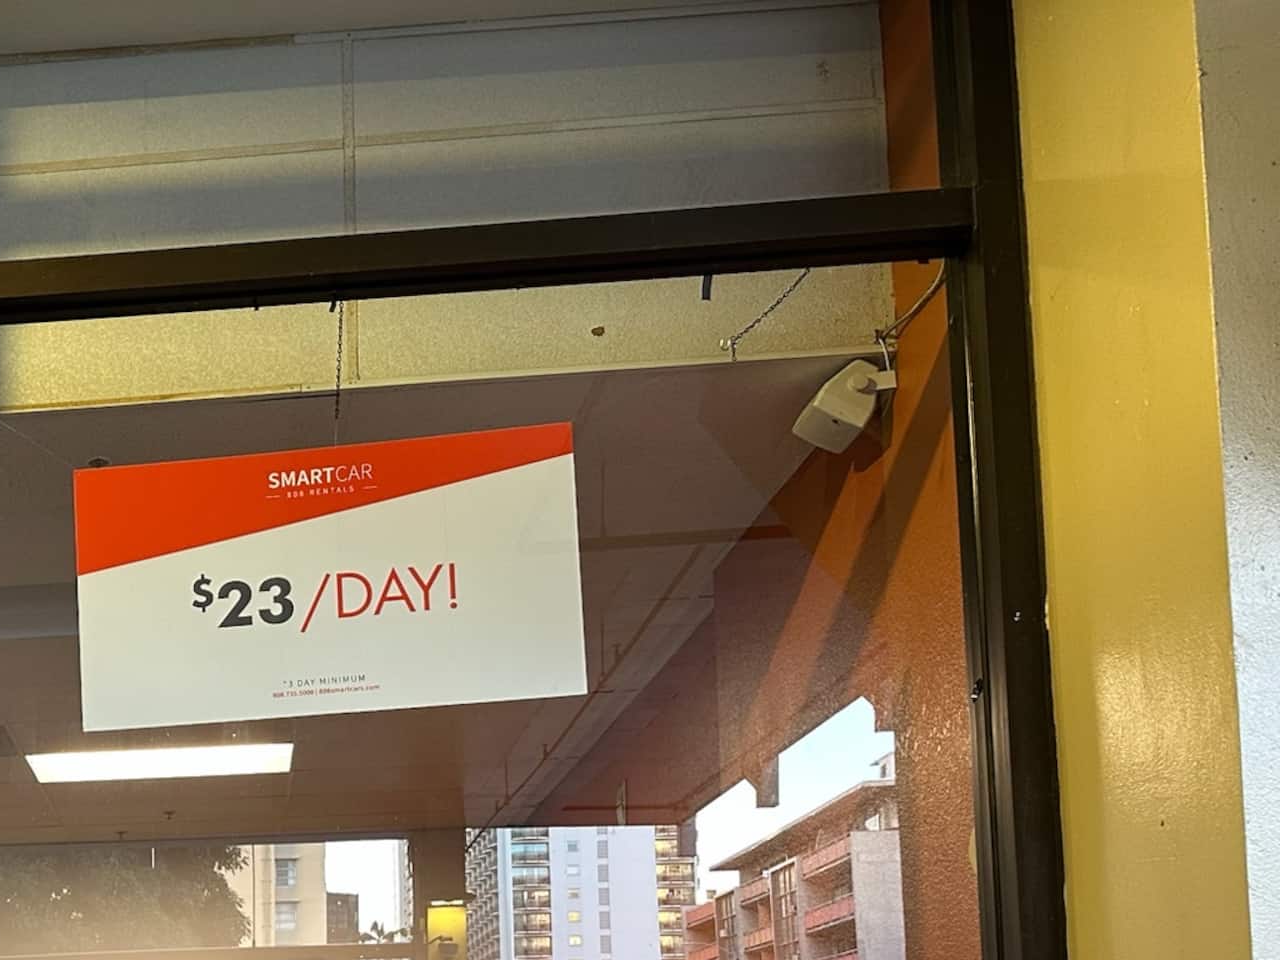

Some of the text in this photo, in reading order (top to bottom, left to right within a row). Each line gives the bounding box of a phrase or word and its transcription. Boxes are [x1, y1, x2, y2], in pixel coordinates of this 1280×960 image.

[268, 463, 373, 489] SMARTCAR
[310, 485, 355, 496] RENTALS
[297, 679, 315, 688] DAY
[319, 674, 366, 685] MINIMUM
